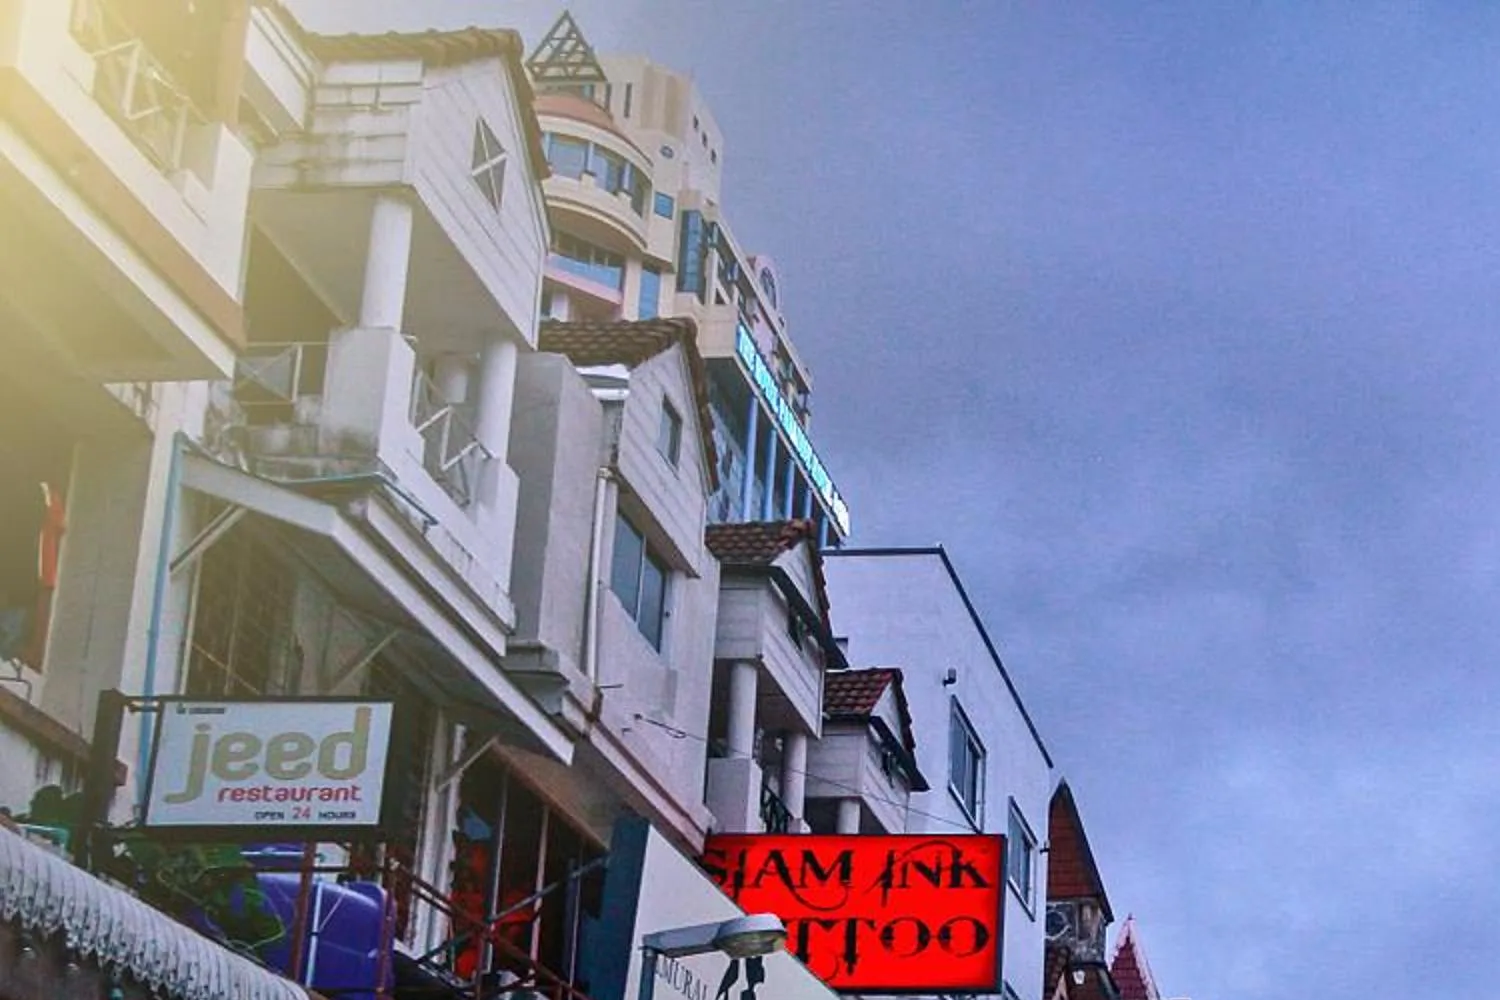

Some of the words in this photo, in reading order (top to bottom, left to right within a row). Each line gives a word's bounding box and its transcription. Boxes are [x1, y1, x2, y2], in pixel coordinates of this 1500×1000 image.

[163, 707, 372, 804] jeed
[217, 785, 362, 802] restaurant
[255, 810, 285, 820] OPEN
[292, 807, 311, 819] 24
[318, 810, 357, 820] HOURS
[783, 915, 993, 977] TTOO
